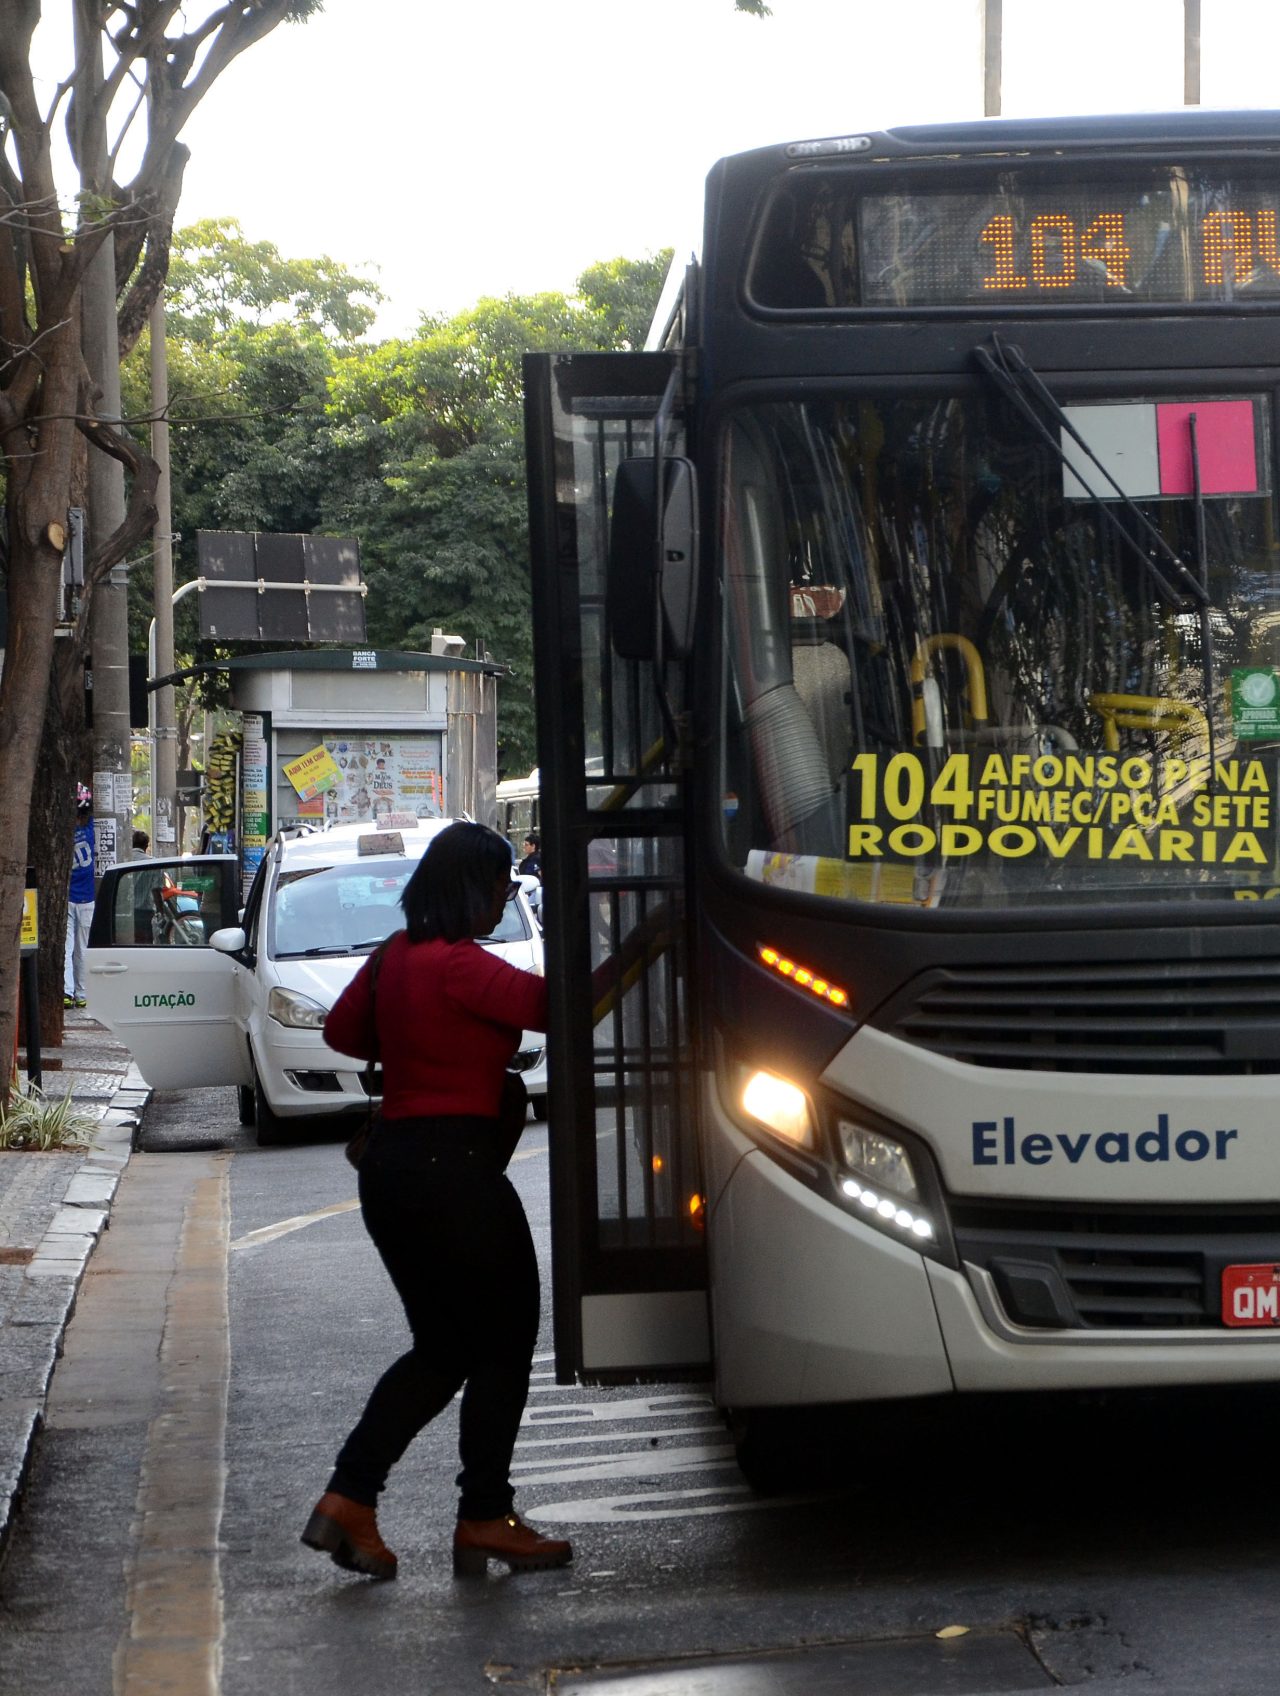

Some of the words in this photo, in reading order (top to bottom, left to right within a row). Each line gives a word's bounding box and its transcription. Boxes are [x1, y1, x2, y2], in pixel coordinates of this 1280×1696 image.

[981, 213, 1131, 289] 104
[851, 752, 974, 821] 104
[979, 753, 1154, 790] AFONSO
[1164, 757, 1270, 793] PENA
[1192, 794, 1271, 828] SETE
[848, 822, 1269, 864] RODOVIÁRIA
[134, 990, 196, 1009] LOTAÇÃO
[970, 1113, 1238, 1167] Elevador
